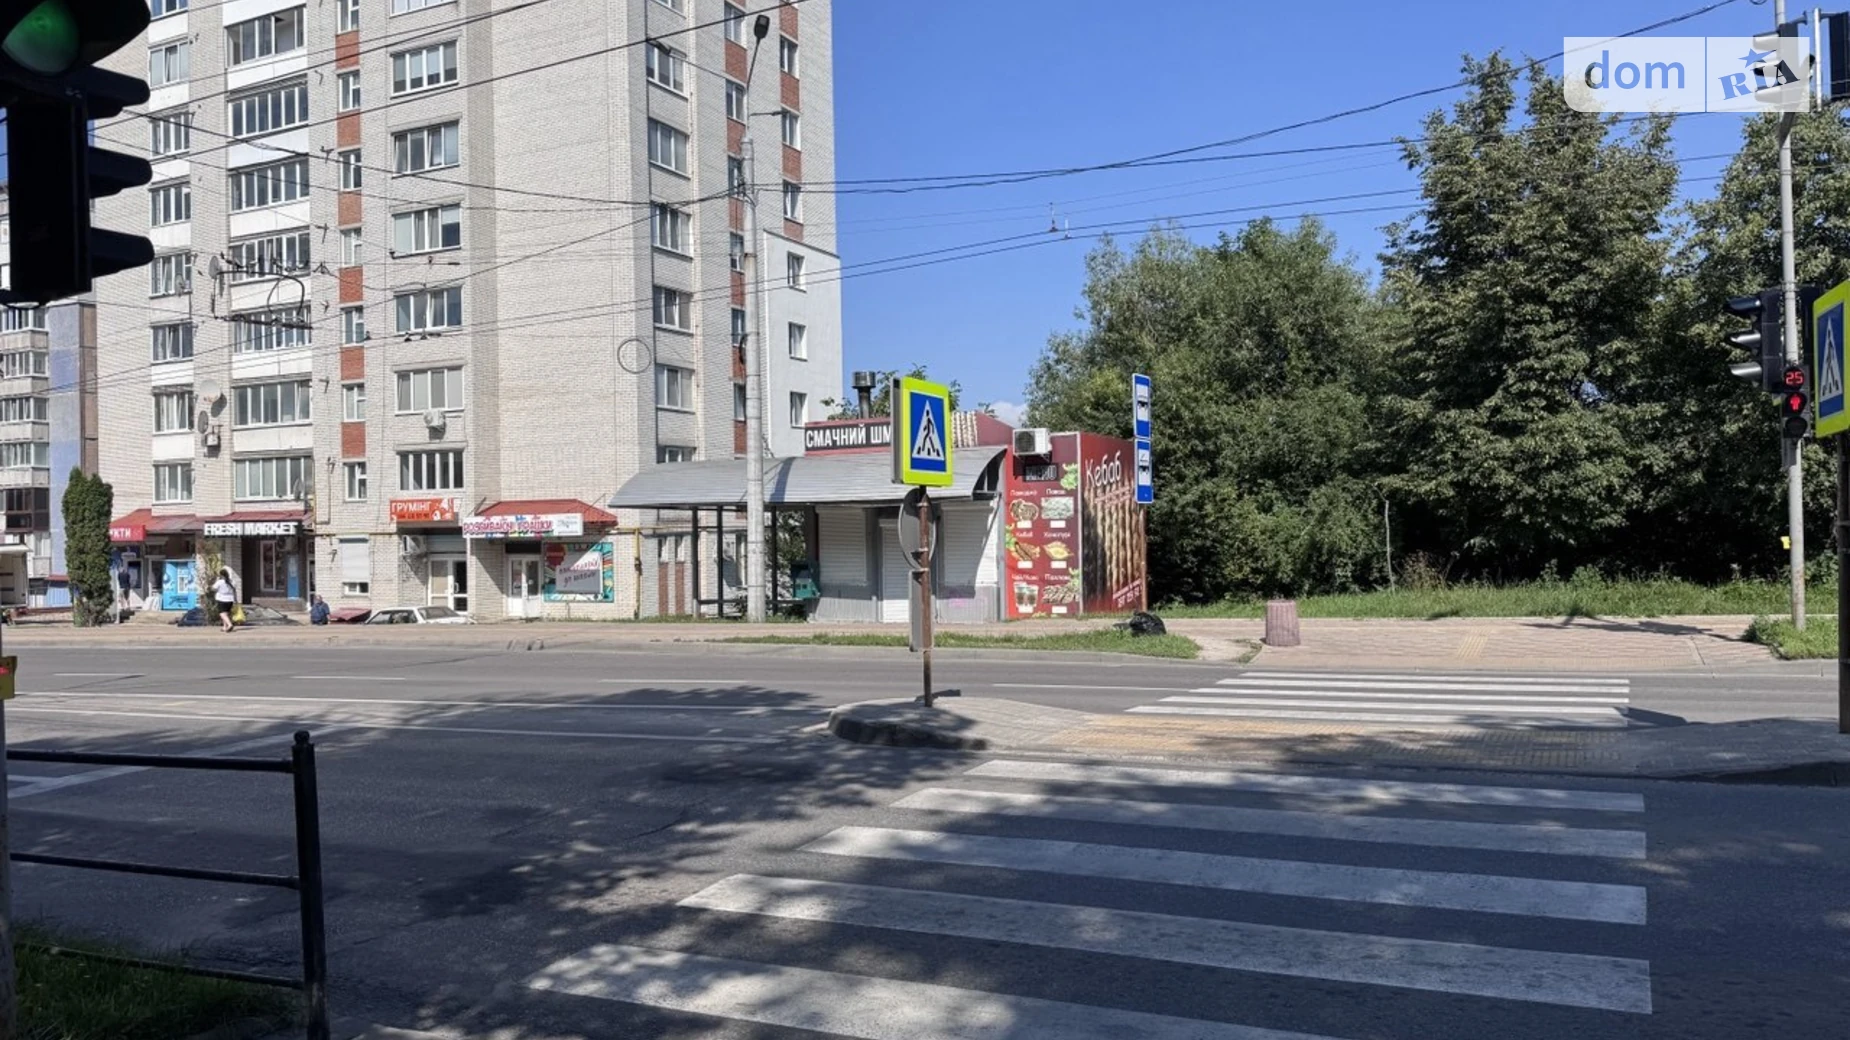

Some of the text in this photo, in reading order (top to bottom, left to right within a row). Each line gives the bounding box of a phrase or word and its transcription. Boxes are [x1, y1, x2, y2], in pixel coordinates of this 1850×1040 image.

[1785, 371, 1804, 386] 25
[806, 423, 866, 447] СМАЧНИЙ
[1084, 450, 1122, 488] Кебаб
[391, 501, 432, 513] ГРУМІНГ
[204, 521, 299, 536] FRESH MARKET
